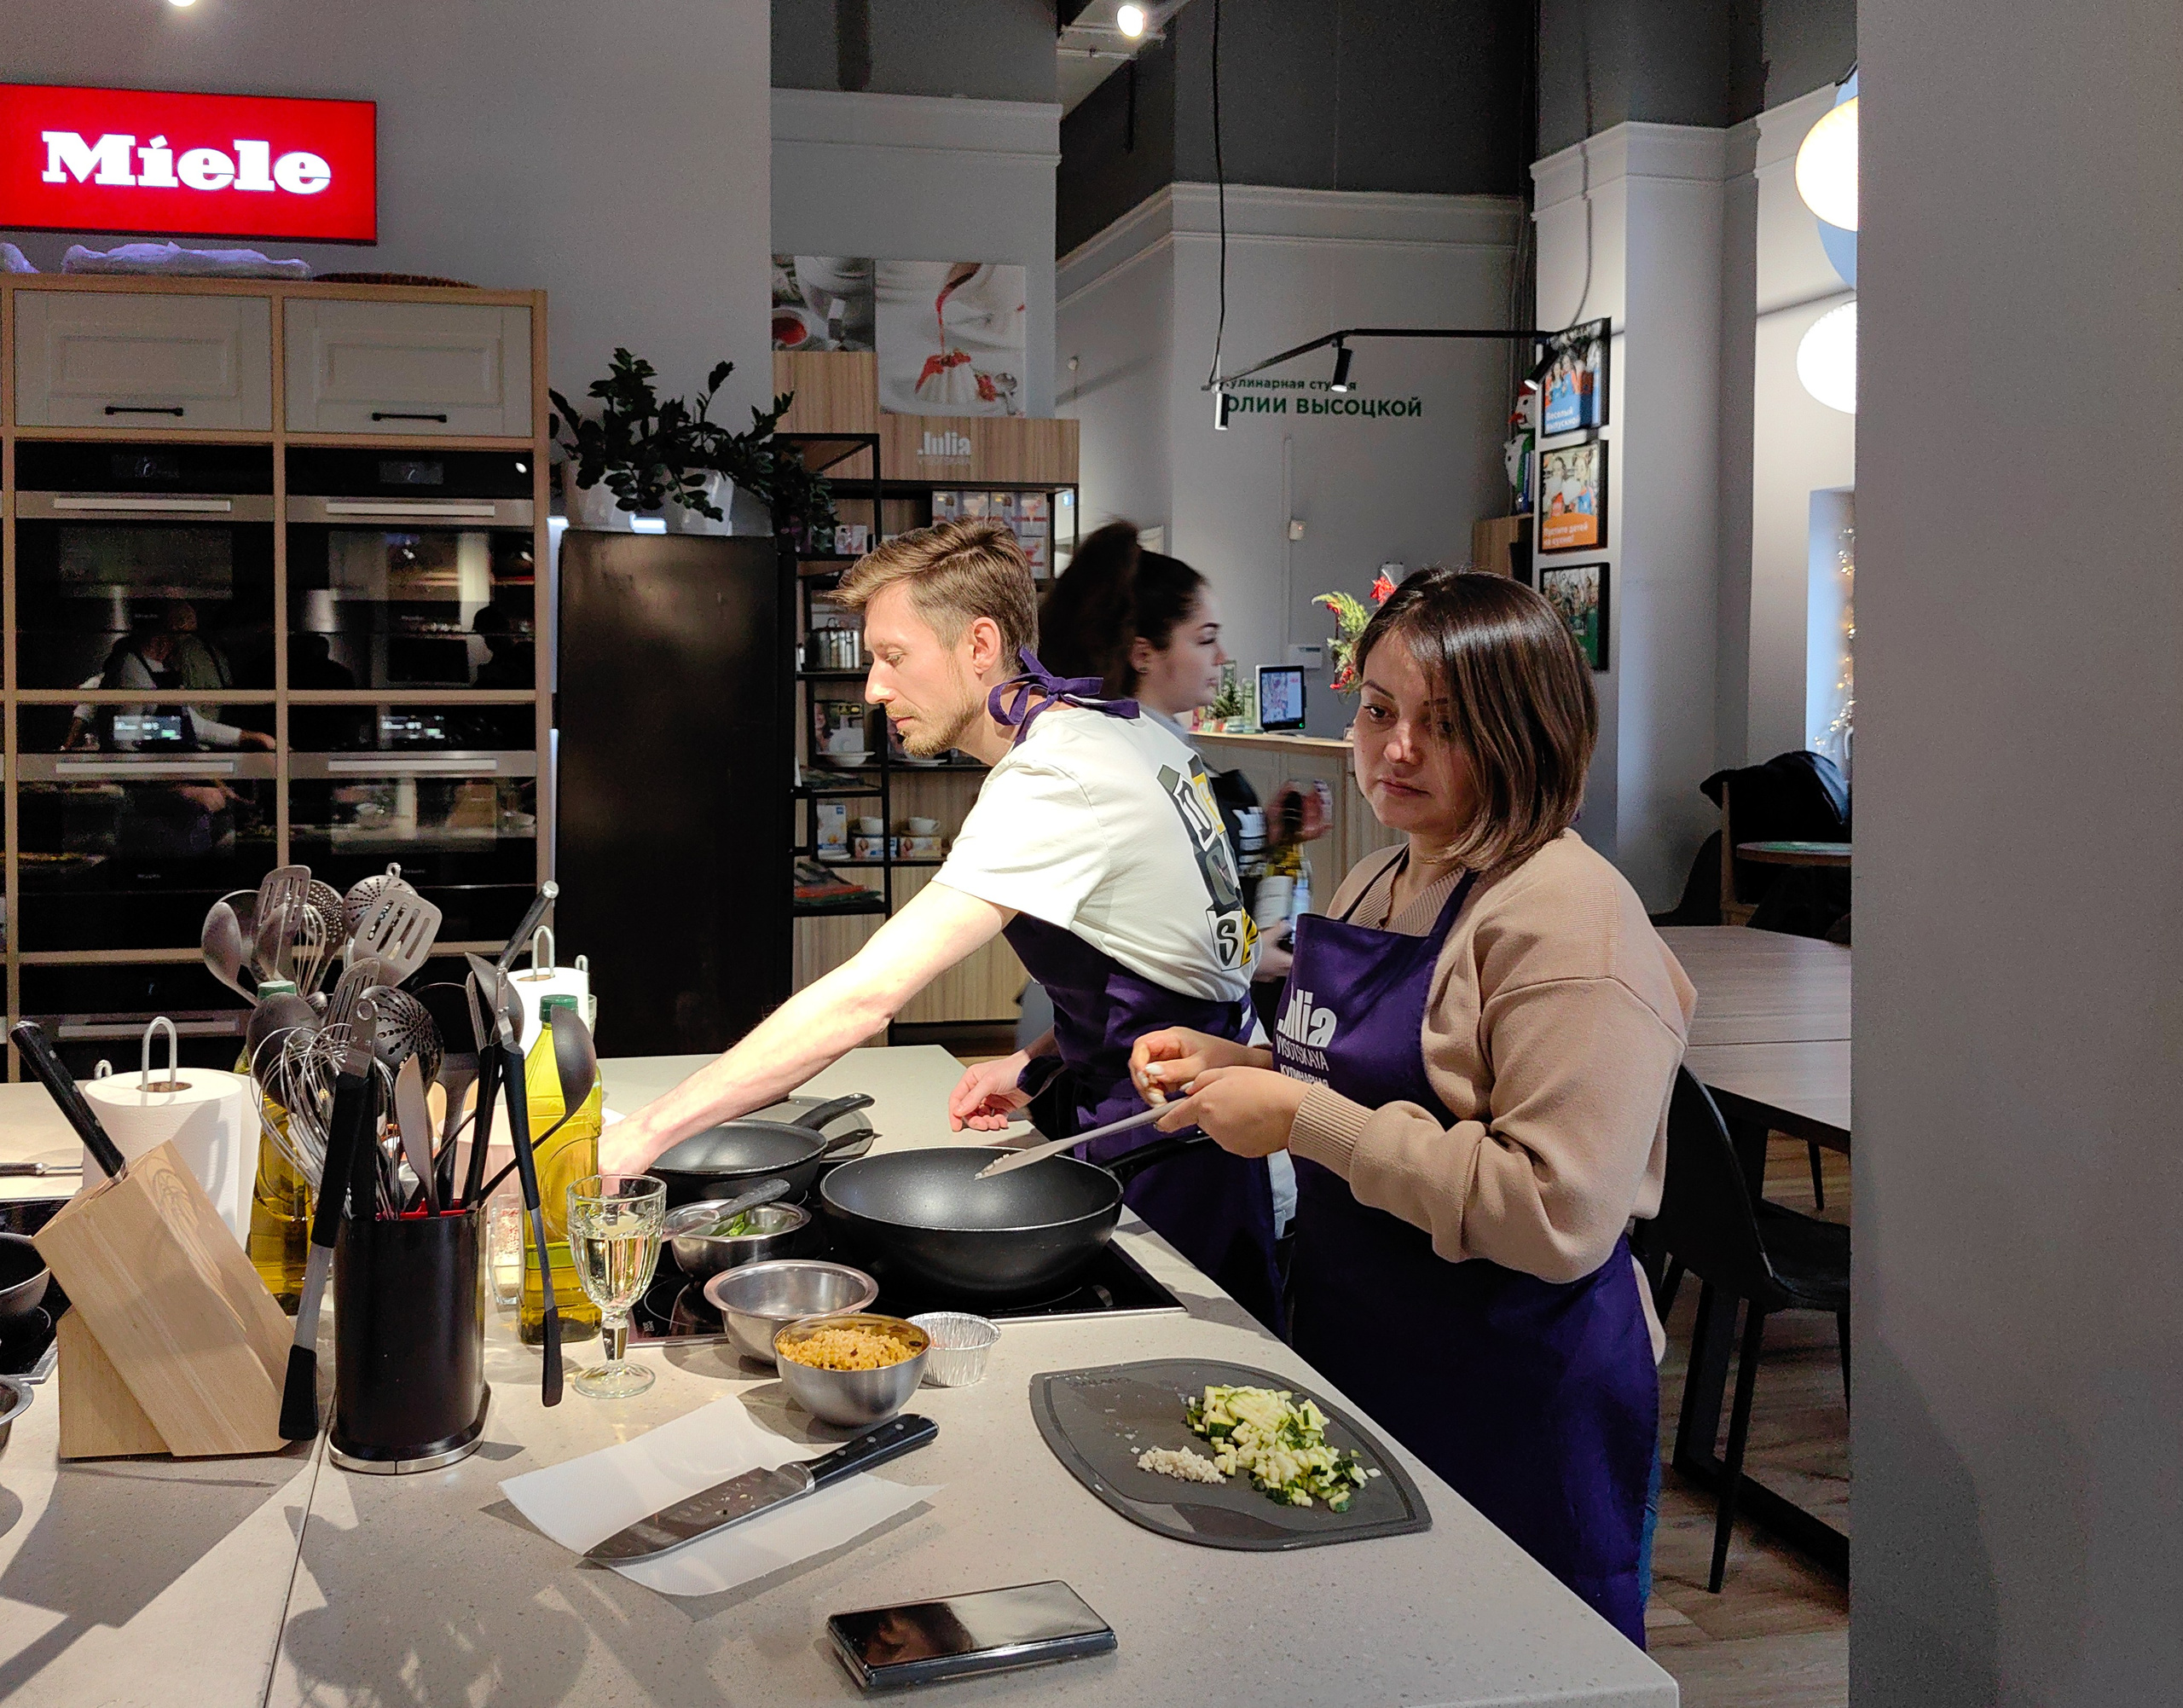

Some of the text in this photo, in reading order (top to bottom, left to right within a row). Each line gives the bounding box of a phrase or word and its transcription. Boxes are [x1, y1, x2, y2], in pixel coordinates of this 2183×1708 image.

[42, 130, 332, 194] Miele
[1310, 380, 1357, 392] стуя
[917, 431, 970, 455] Julia
[1276, 1033, 1329, 1071] VYSOTSKAYA
